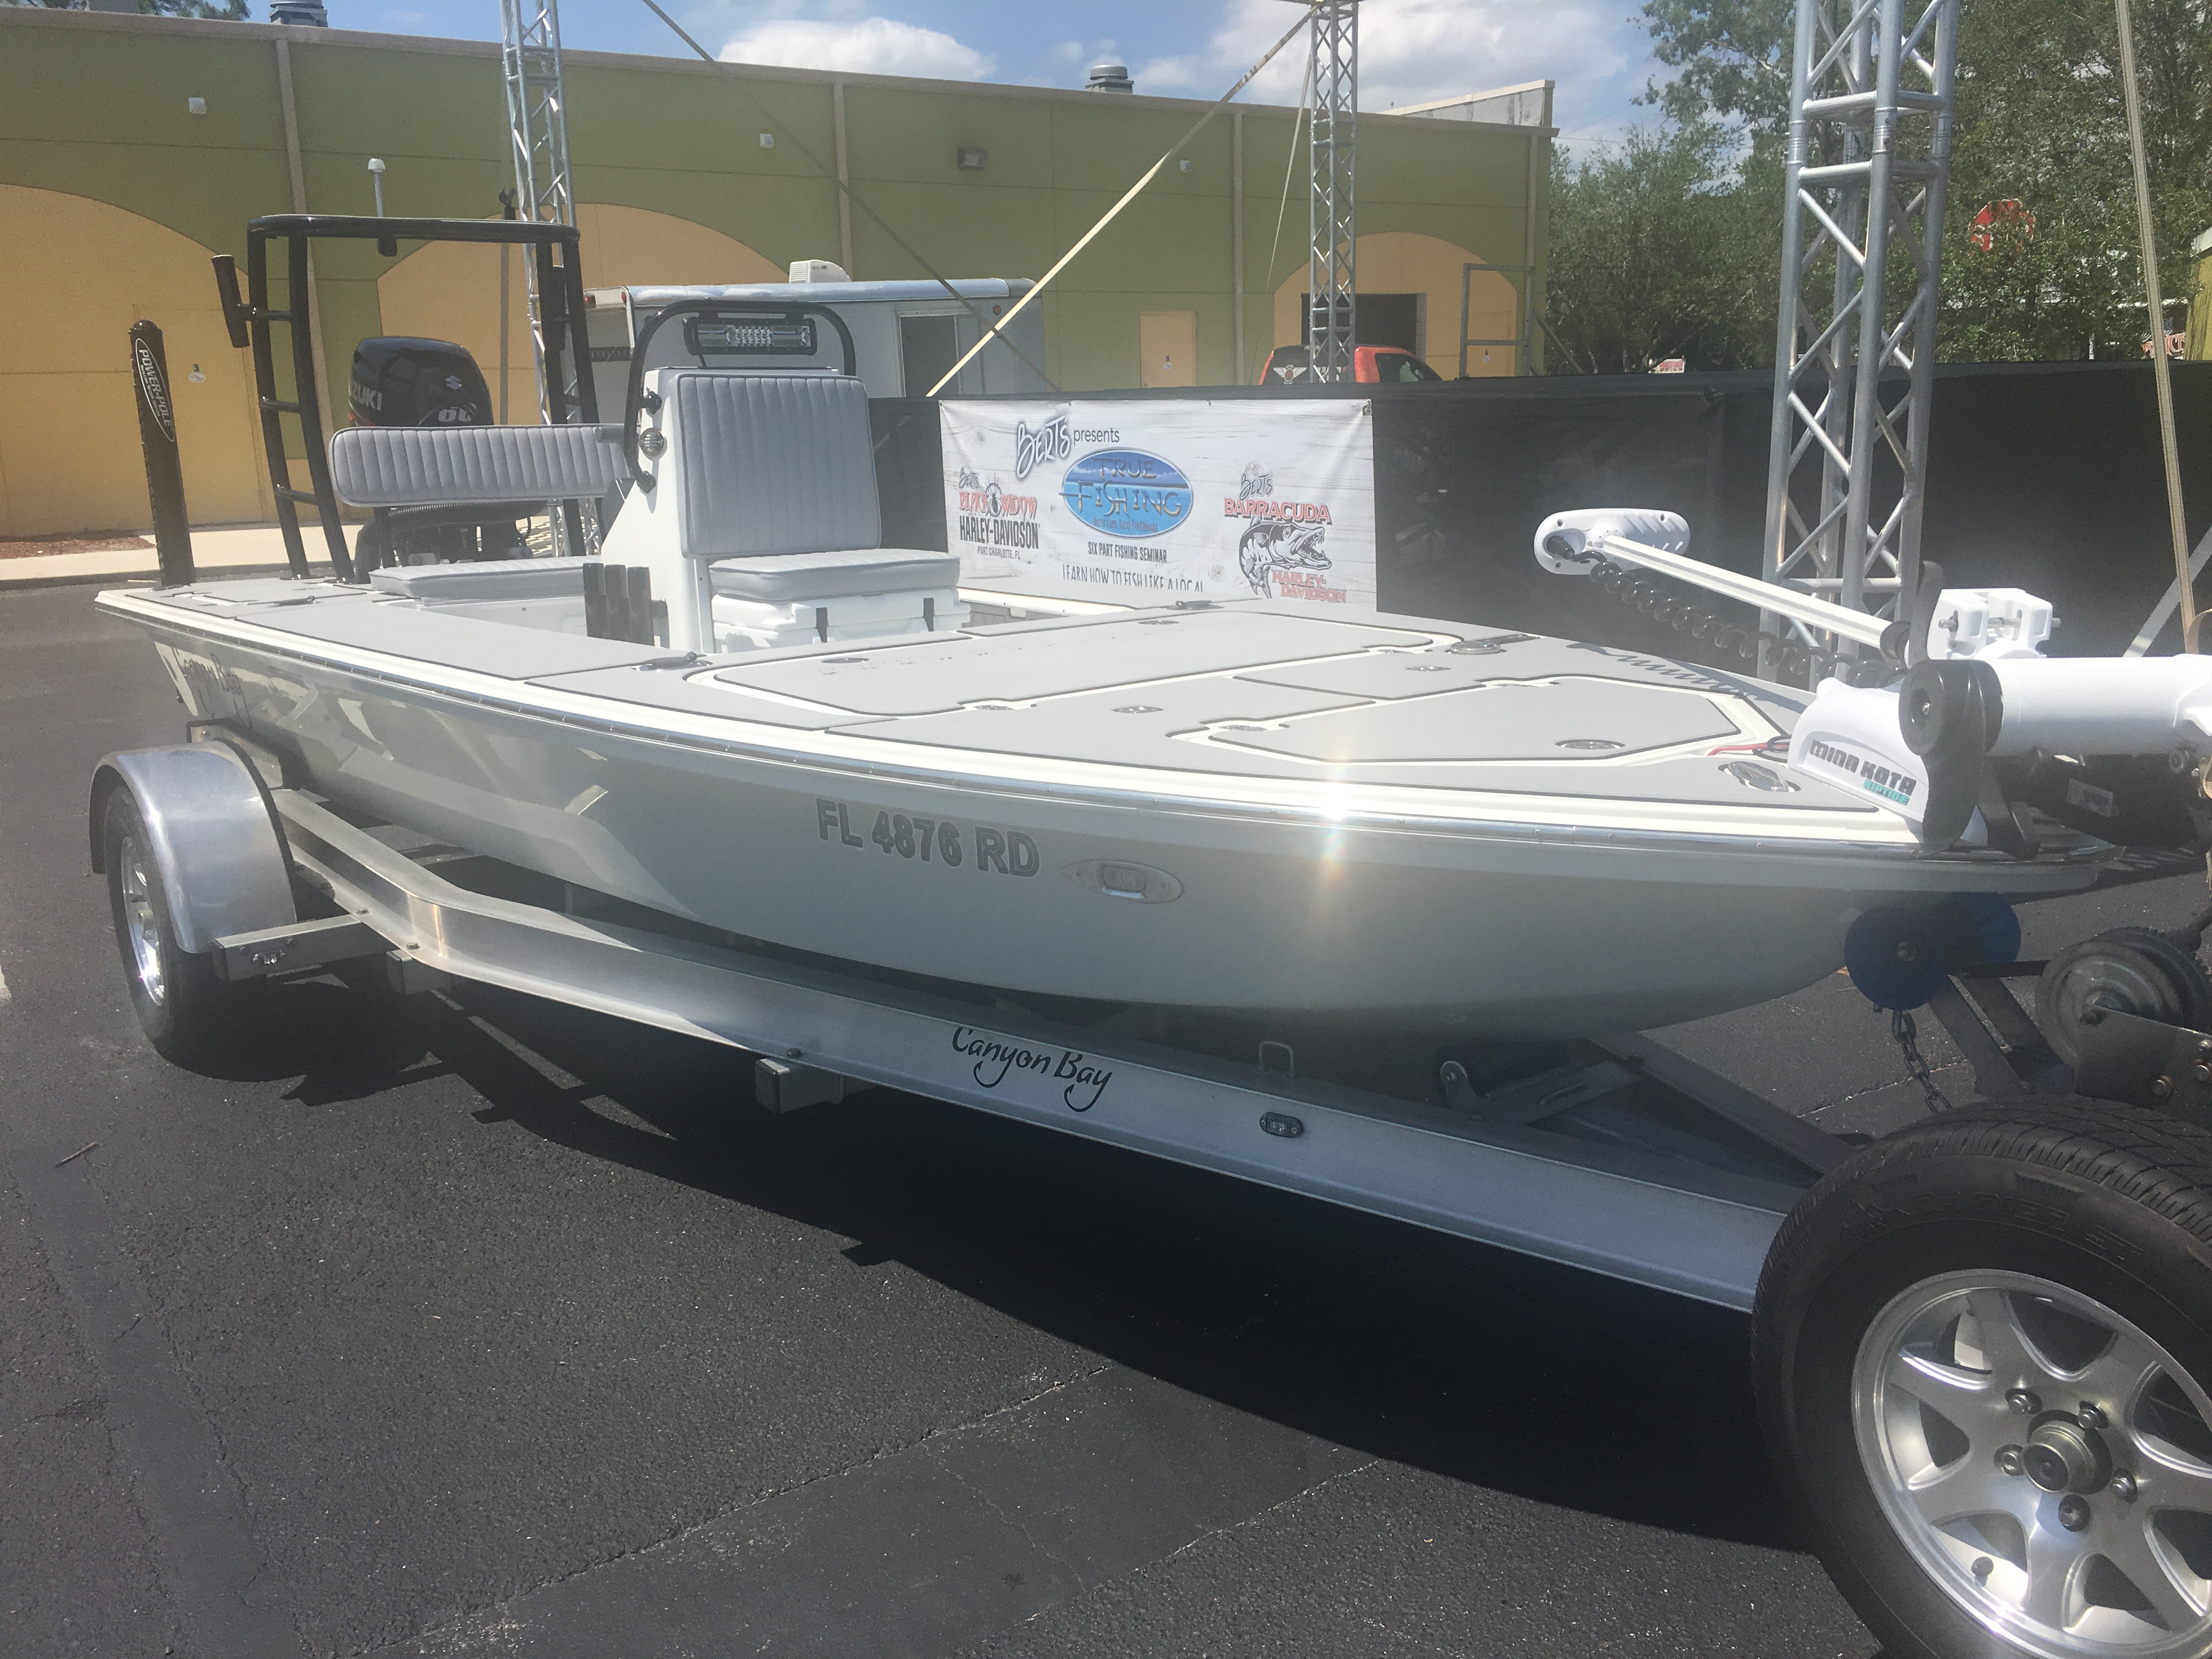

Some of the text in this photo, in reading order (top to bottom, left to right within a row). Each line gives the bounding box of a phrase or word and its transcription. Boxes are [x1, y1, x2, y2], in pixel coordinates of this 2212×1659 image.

[139, 349, 172, 427] POWER-POLE
[1074, 428, 1120, 446] presents
[1094, 457, 1157, 480] TRUE
[959, 492, 1037, 522] BLACK WIDOW
[1058, 480, 1182, 517] FISHING
[1224, 498, 1333, 525] BARRACUDA
[960, 515, 1039, 549] HARLEY-DAVIDSON
[977, 545, 988, 556] PORT
[1015, 550, 1021, 560] FL
[1088, 541, 1167, 563] SIX PART FISHING SEMINAR
[1063, 564, 1087, 582] LEARN
[1090, 568, 1109, 584] HOW
[1111, 570, 1122, 585] TO
[1280, 583, 1347, 603] DAVIDSON
[1809, 740, 1917, 796] MINN KOTA
[1863, 780, 1910, 806] RIPTIDE
[816, 798, 1040, 877] FL 4876 RD
[952, 1026, 1113, 1113] Canyon Bay
